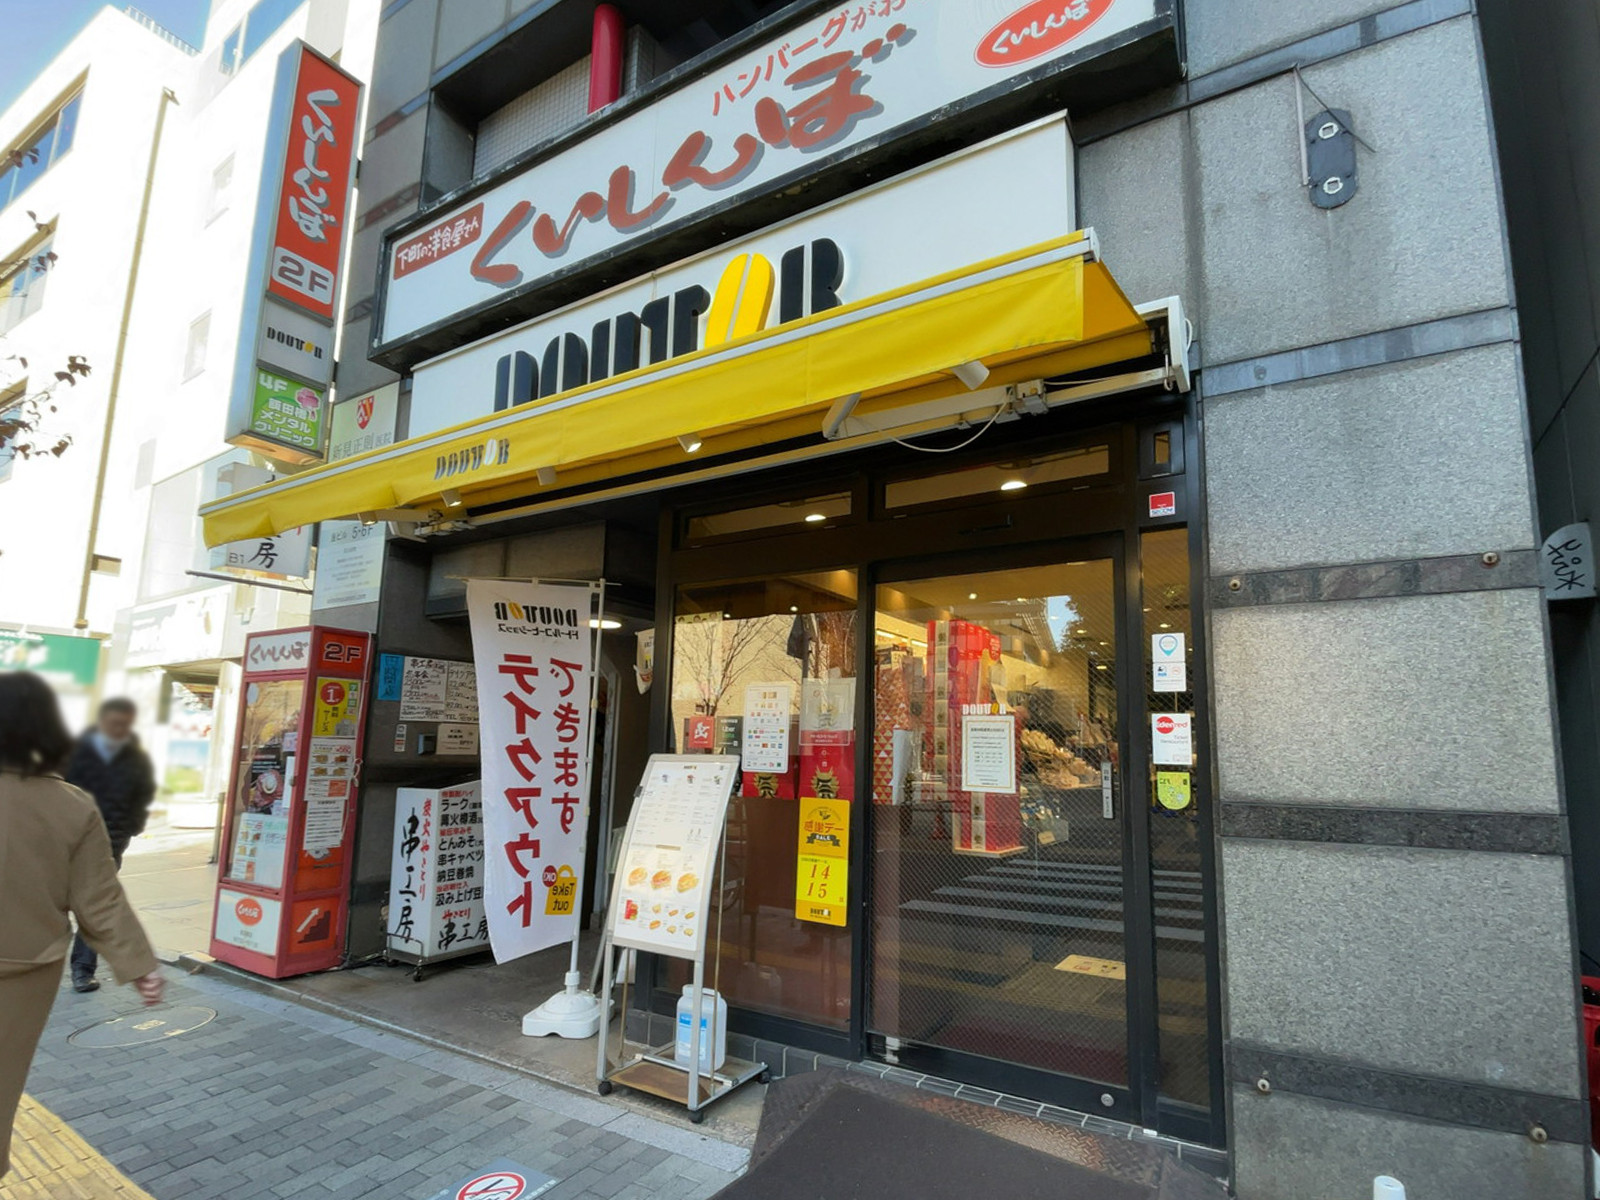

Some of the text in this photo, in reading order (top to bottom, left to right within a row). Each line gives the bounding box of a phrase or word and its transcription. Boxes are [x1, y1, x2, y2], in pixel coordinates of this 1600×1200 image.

[289, 88, 341, 243] くいしんぼ
[470, 22, 917, 288] くいしんぼ
[278, 255, 330, 293] 2F
[266, 326, 323, 359] DOUTOR
[259, 373, 288, 392] 4F
[254, 421, 315, 446] クリニック
[260, 410, 311, 433] メンタル
[434, 438, 510, 480] DOUTOR
[229, 552, 245, 564] B1
[324, 643, 361, 662] 2F
[811, 864, 831, 880] 14
[807, 882, 828, 899] 15
